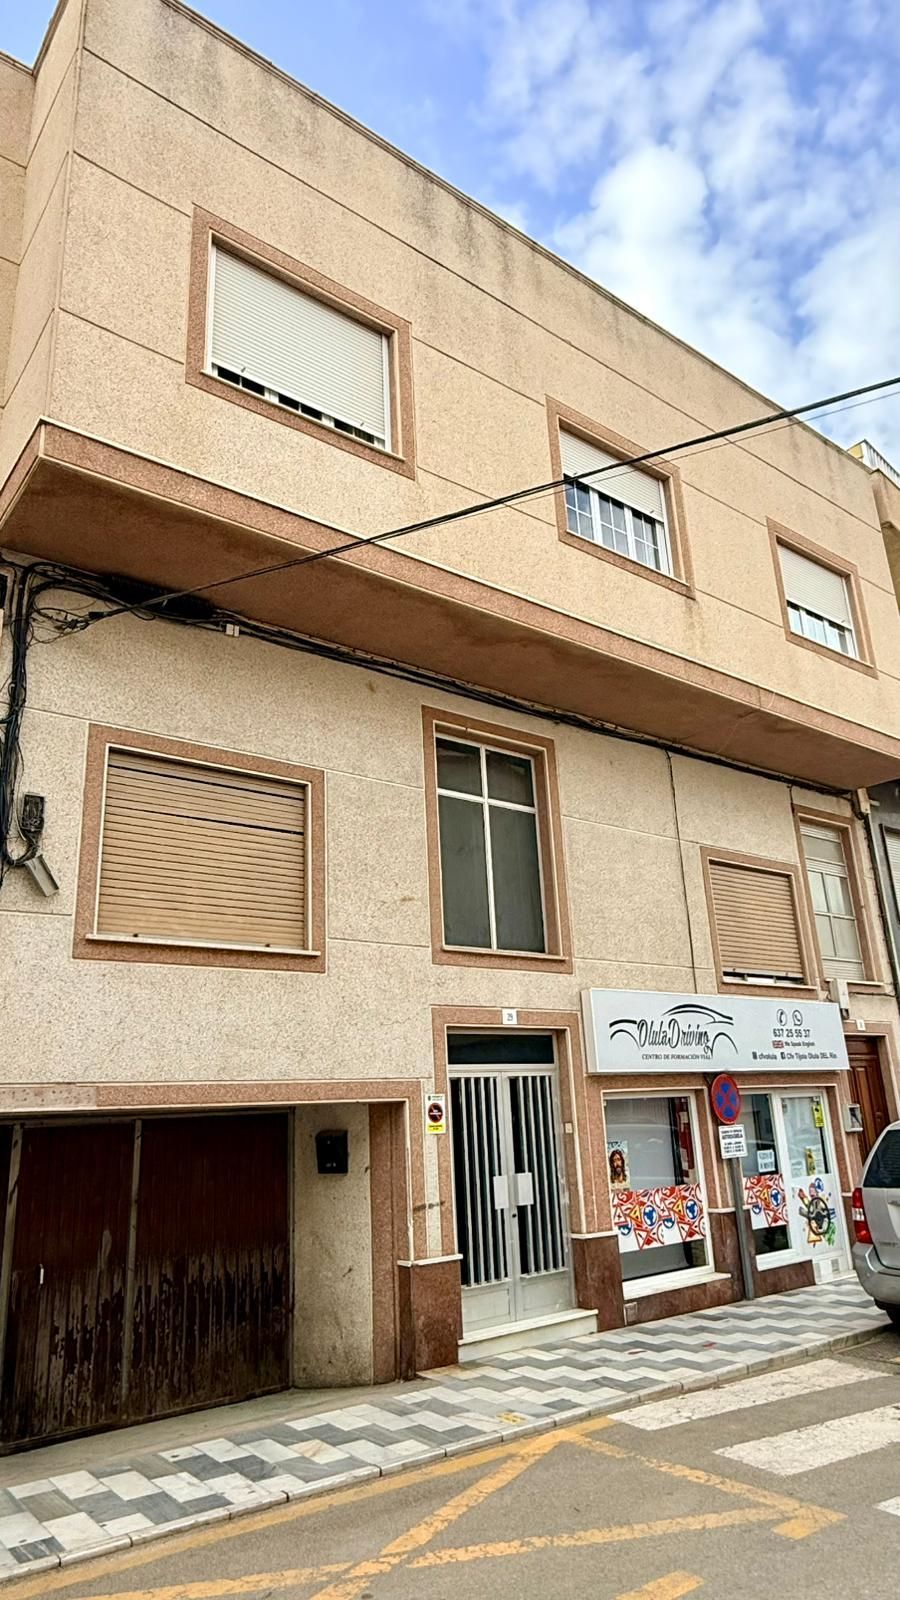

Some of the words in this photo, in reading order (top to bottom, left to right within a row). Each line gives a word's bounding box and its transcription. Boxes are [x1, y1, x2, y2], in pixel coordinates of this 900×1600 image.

[773, 1028, 784, 1037] 637
[786, 1029, 794, 1037] 25
[795, 1029, 803, 1037] 55
[803, 1029, 811, 1037] 37
